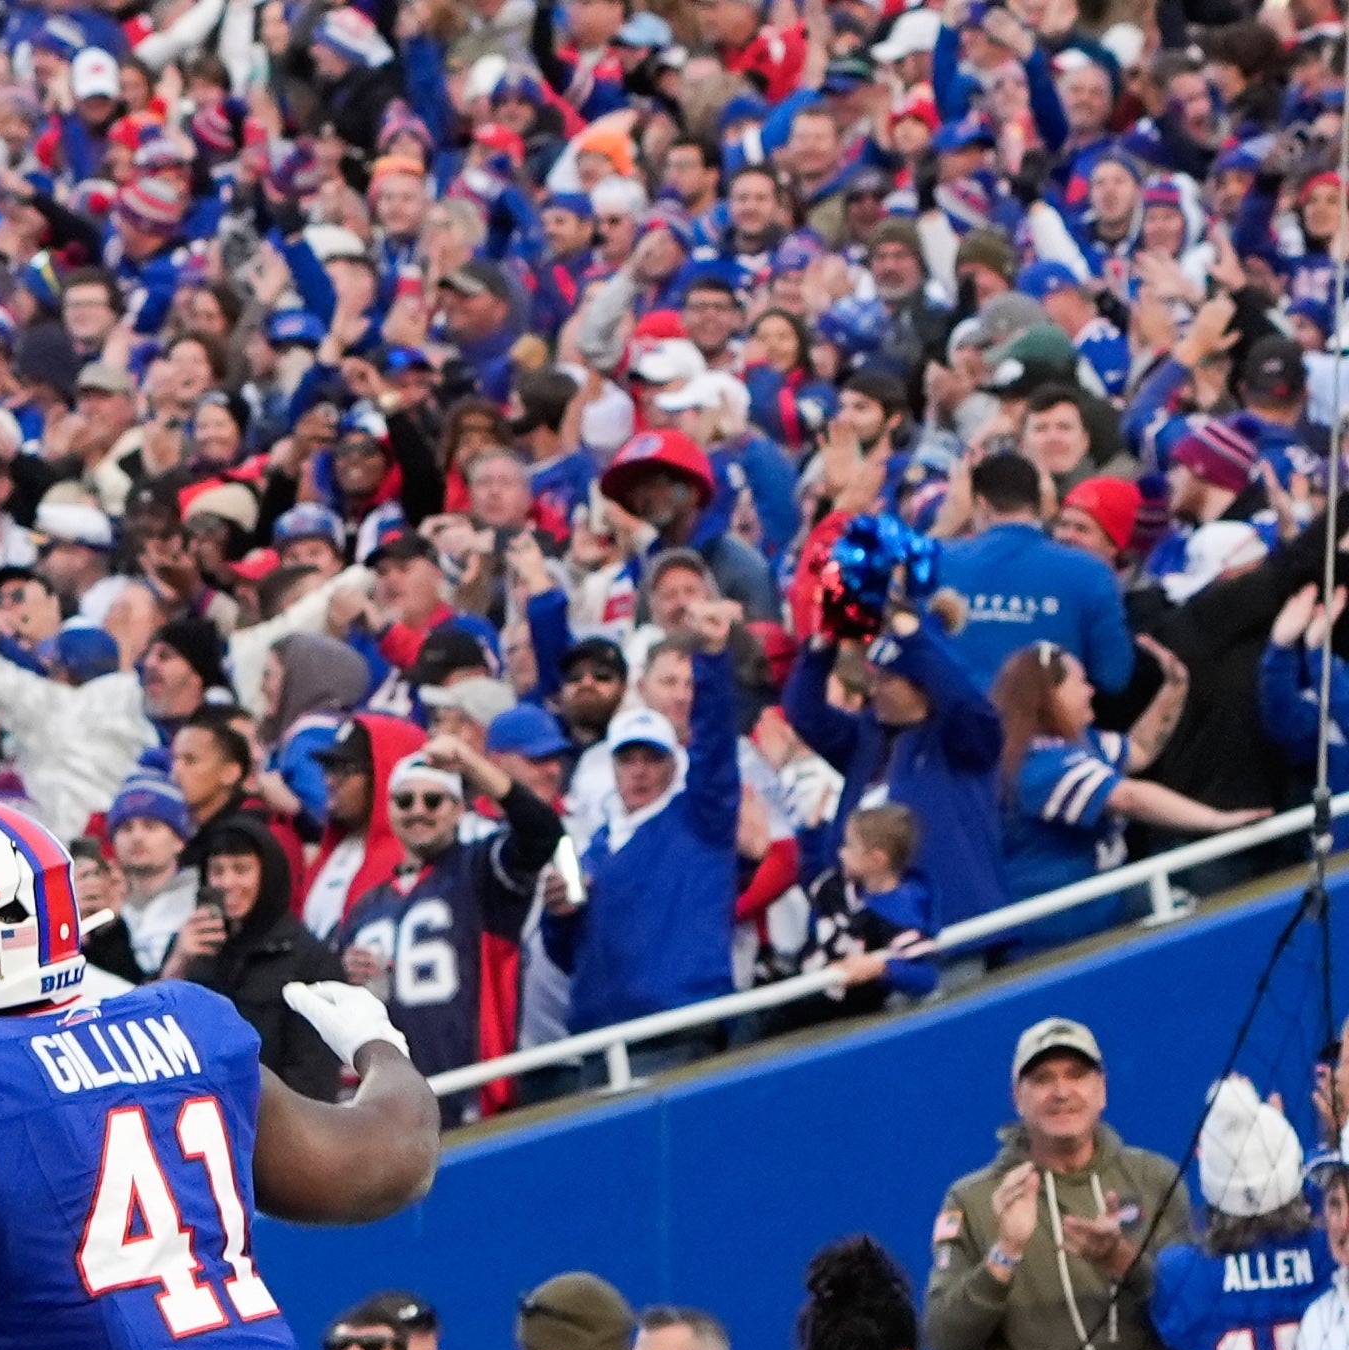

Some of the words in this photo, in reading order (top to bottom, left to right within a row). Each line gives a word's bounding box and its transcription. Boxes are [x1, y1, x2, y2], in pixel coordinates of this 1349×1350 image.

[41, 966, 86, 995] BILL
[31, 1014, 201, 1094] GILLIAM
[74, 1095, 280, 1339] 41
[1223, 1250, 1315, 1293] ALLEN
